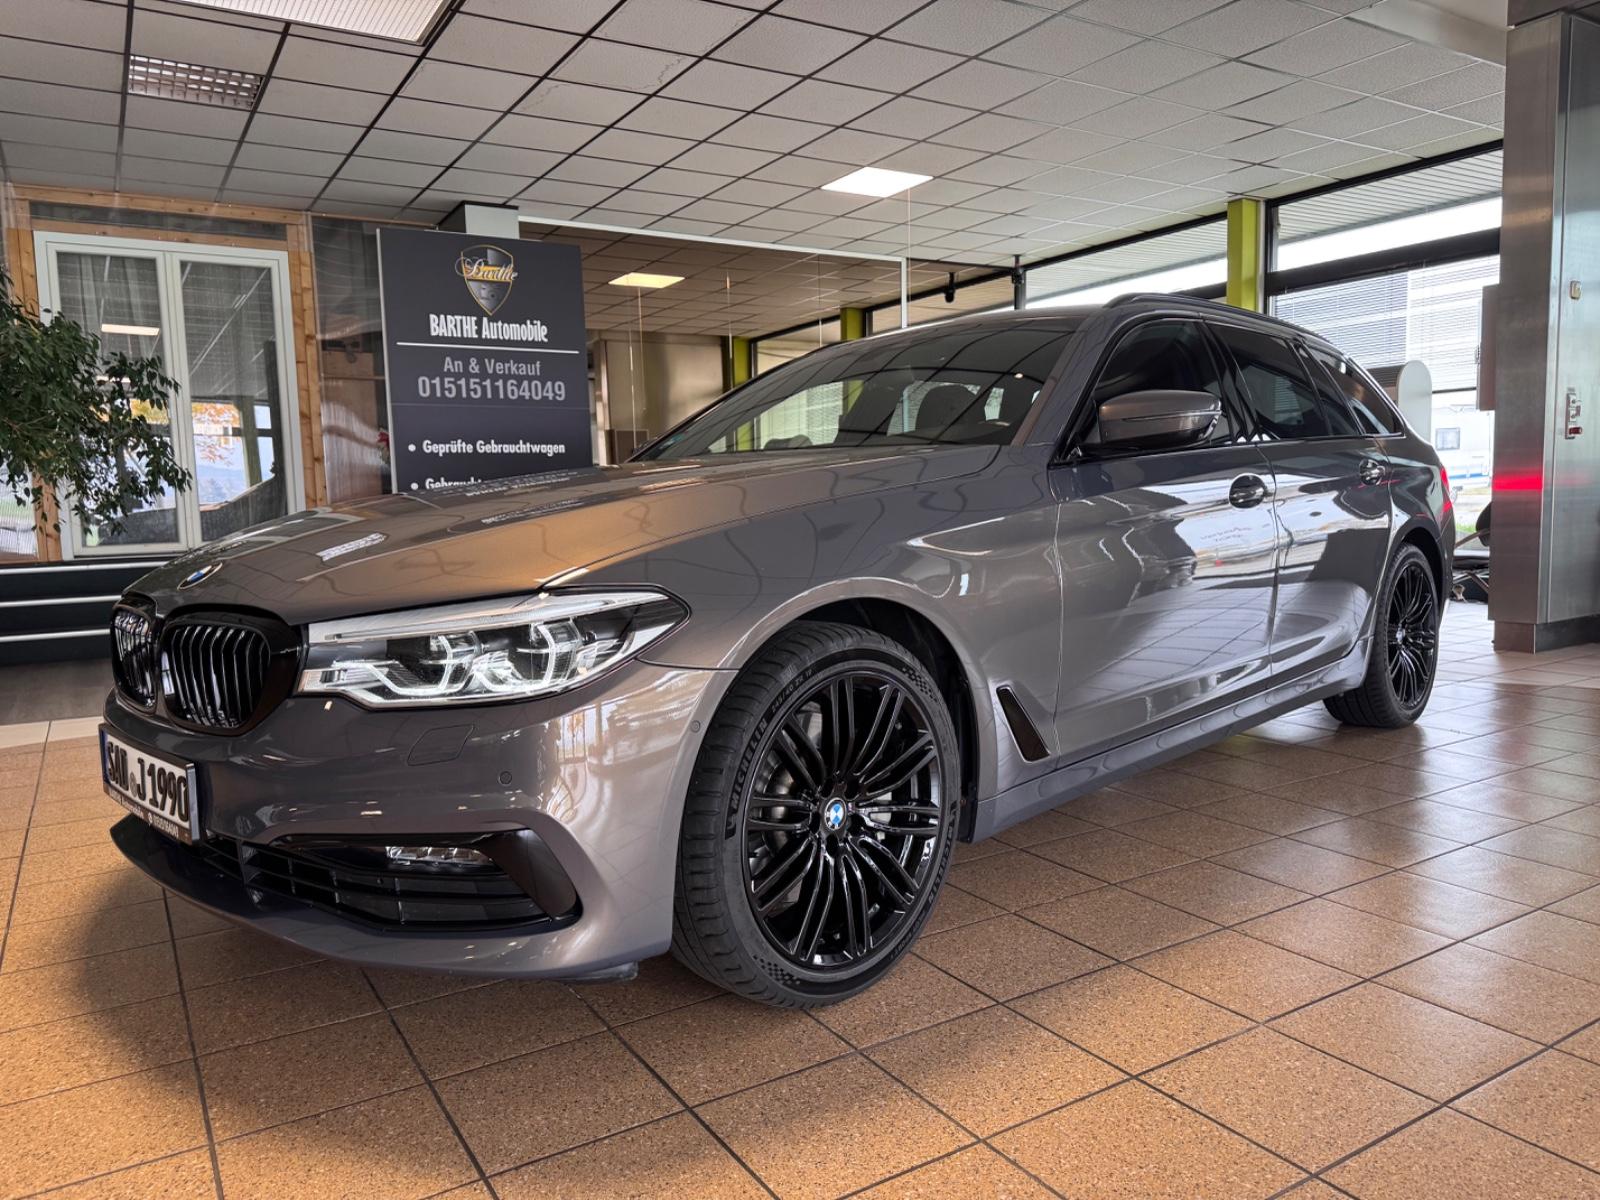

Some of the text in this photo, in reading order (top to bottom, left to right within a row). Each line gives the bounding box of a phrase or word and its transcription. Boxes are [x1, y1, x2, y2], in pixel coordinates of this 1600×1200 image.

[429, 314, 549, 342] BARTHE Automobile
[444, 357, 541, 376] An & Verkauf
[417, 376, 566, 401] 015151164049
[423, 439, 566, 457] Geprüfte Gebrauchtwagen
[730, 718, 768, 810] MICHELIN
